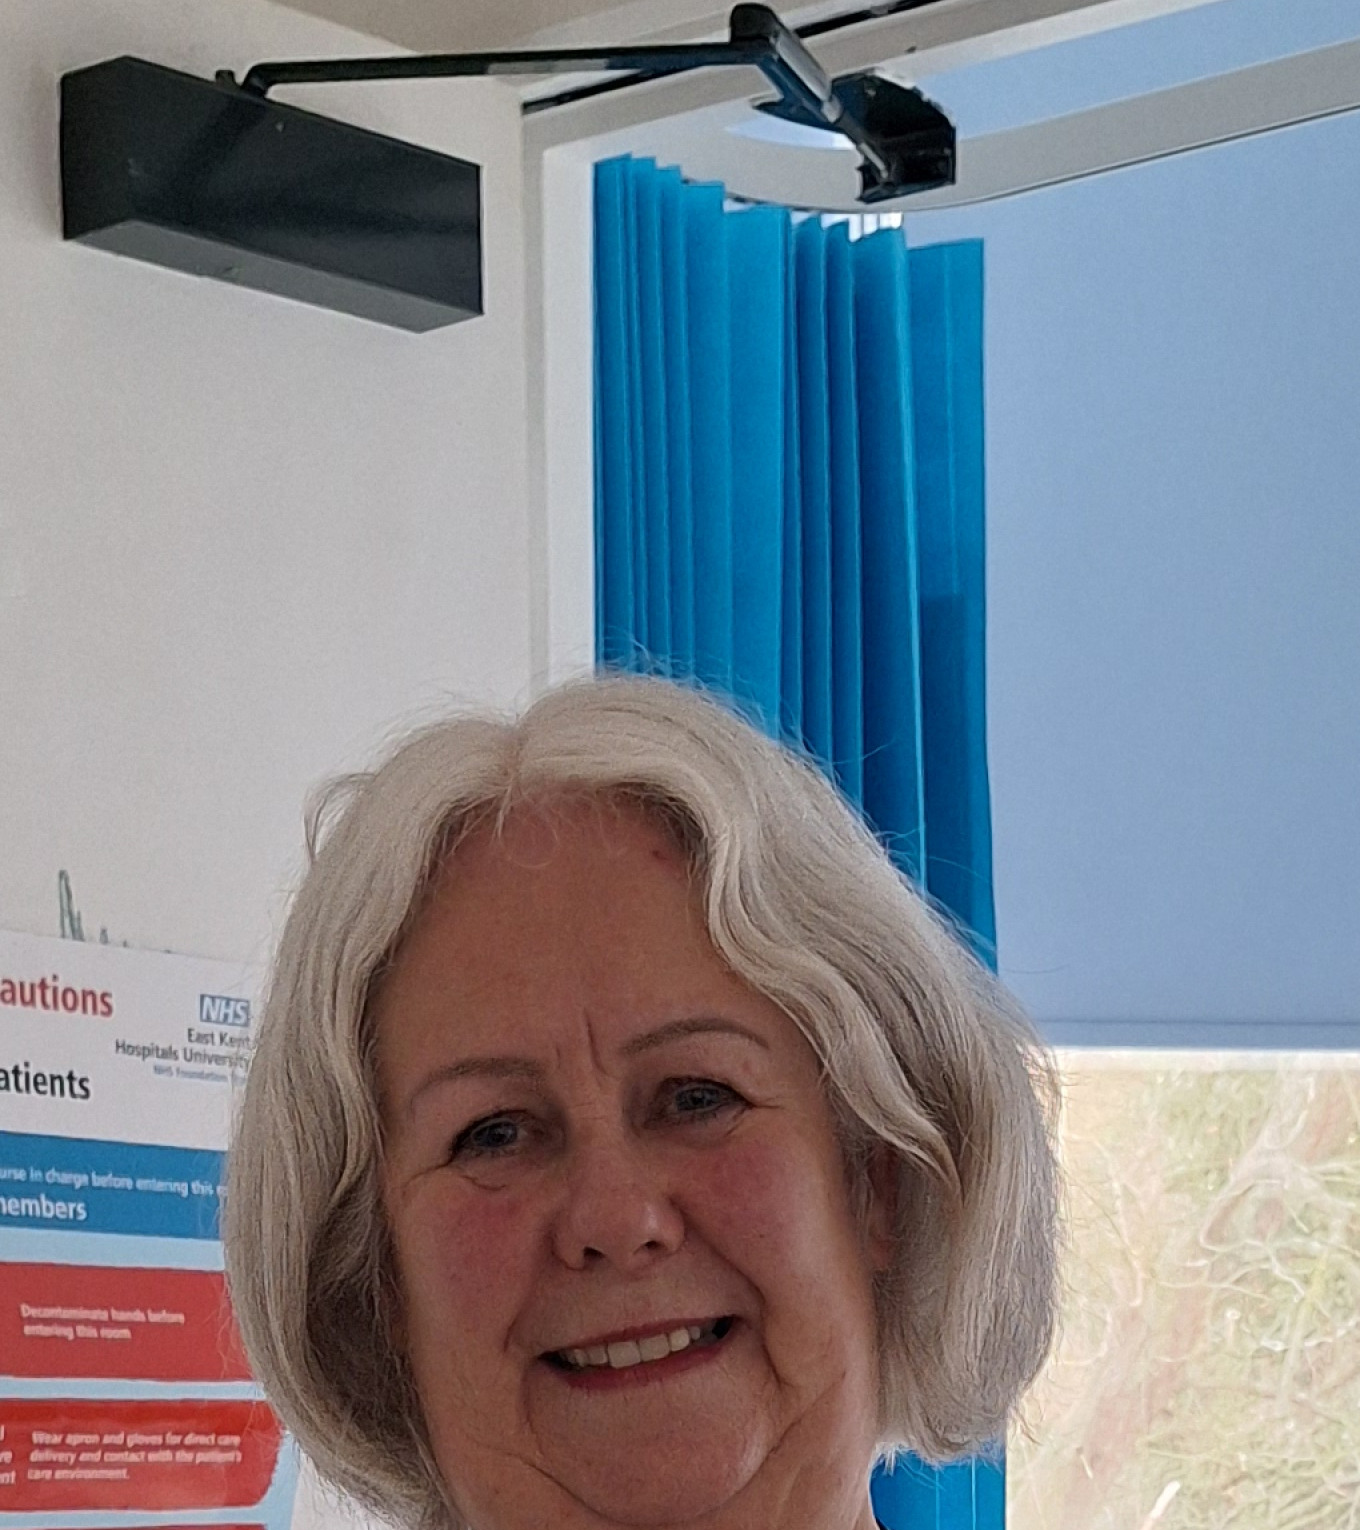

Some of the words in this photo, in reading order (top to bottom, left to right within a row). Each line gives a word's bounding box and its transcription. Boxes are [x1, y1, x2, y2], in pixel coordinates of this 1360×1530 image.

[202, 996, 248, 1025] NHS
[187, 1028, 214, 1045] East
[115, 1038, 179, 1062] Hospitals
[183, 1047, 250, 1071] University
[30, 1167, 43, 1183] in
[45, 1168, 89, 1189] charge
[91, 1171, 133, 1190] before
[136, 1178, 189, 1198] entering
[31, 1431, 63, 1445] Wear
[103, 1431, 125, 1445] and
[29, 1450, 77, 1465] delivery
[78, 1449, 102, 1462] and
